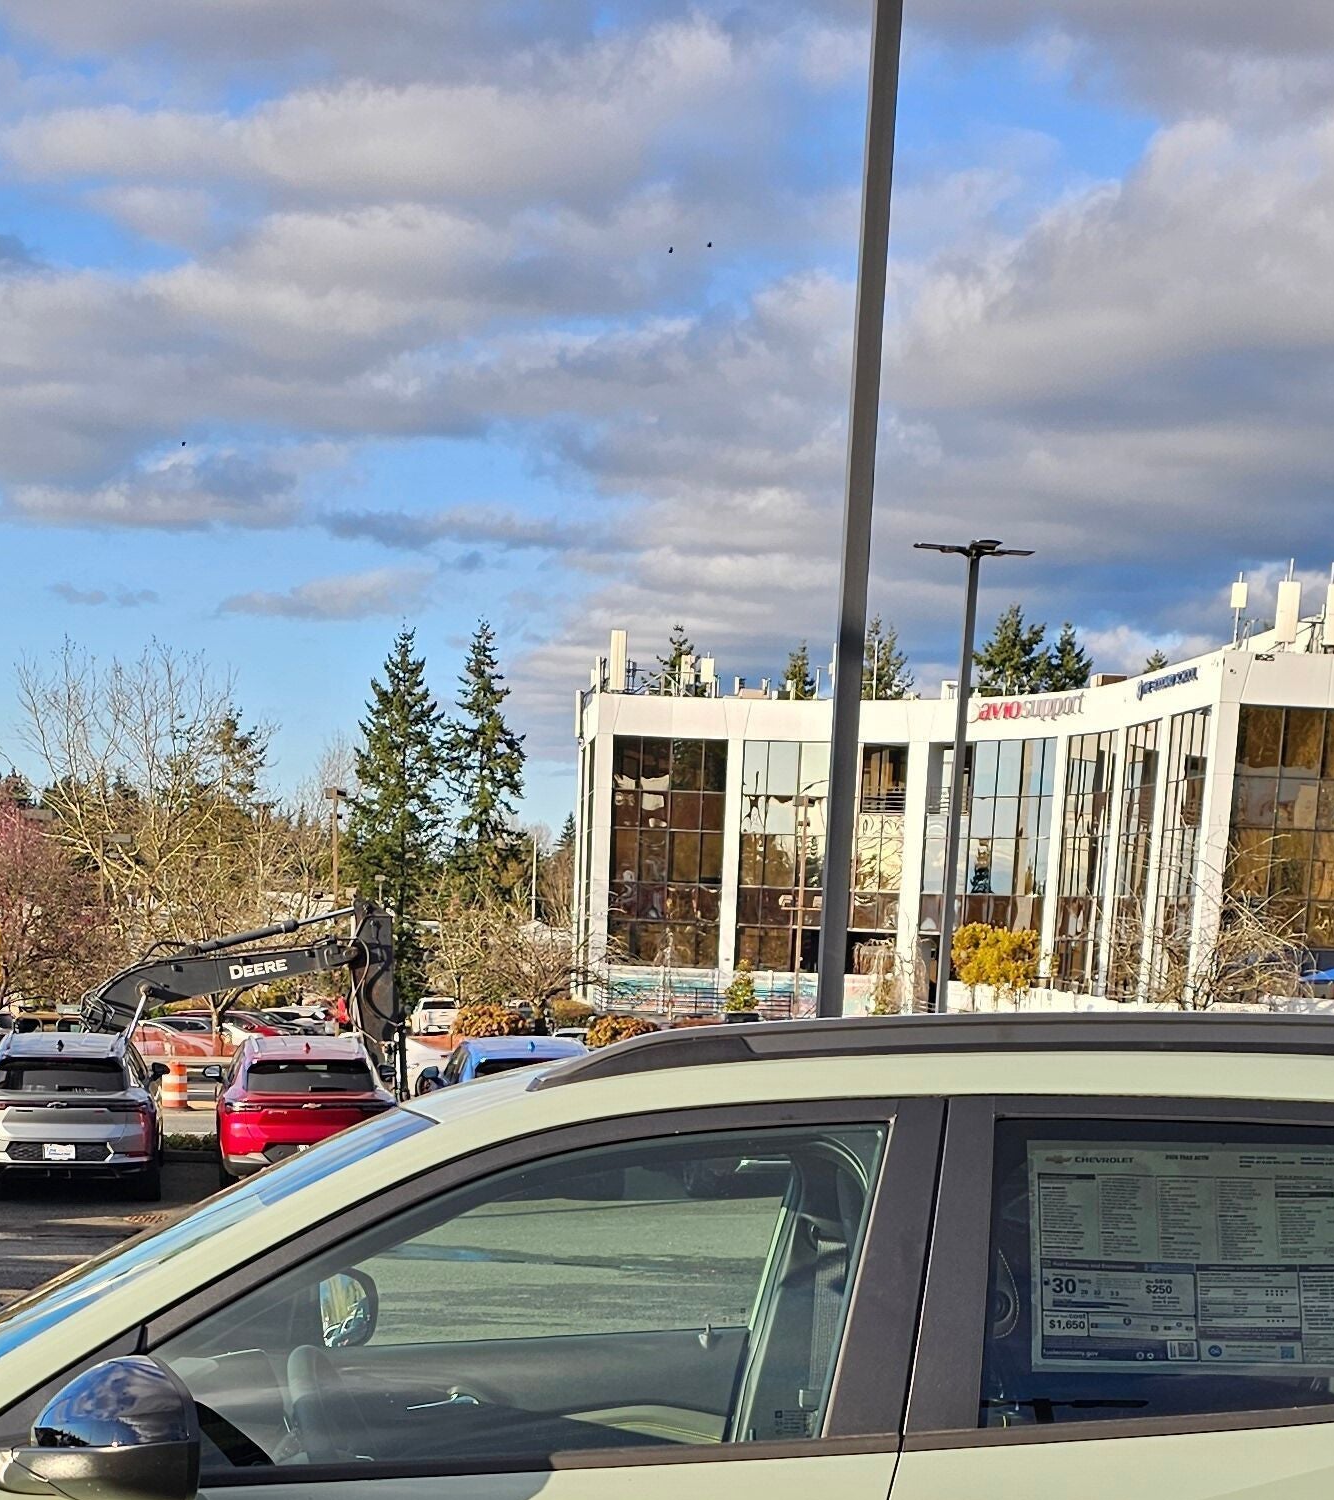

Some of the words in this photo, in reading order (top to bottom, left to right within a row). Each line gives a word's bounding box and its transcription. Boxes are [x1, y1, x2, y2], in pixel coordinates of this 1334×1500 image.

[229, 959, 287, 980] DEERE
[1074, 1156, 1134, 1164] CHEVROLET
[1052, 1278, 1076, 1294] 30
[1146, 1285, 1172, 1295] $250
[1049, 1320, 1085, 1330] $1,650
